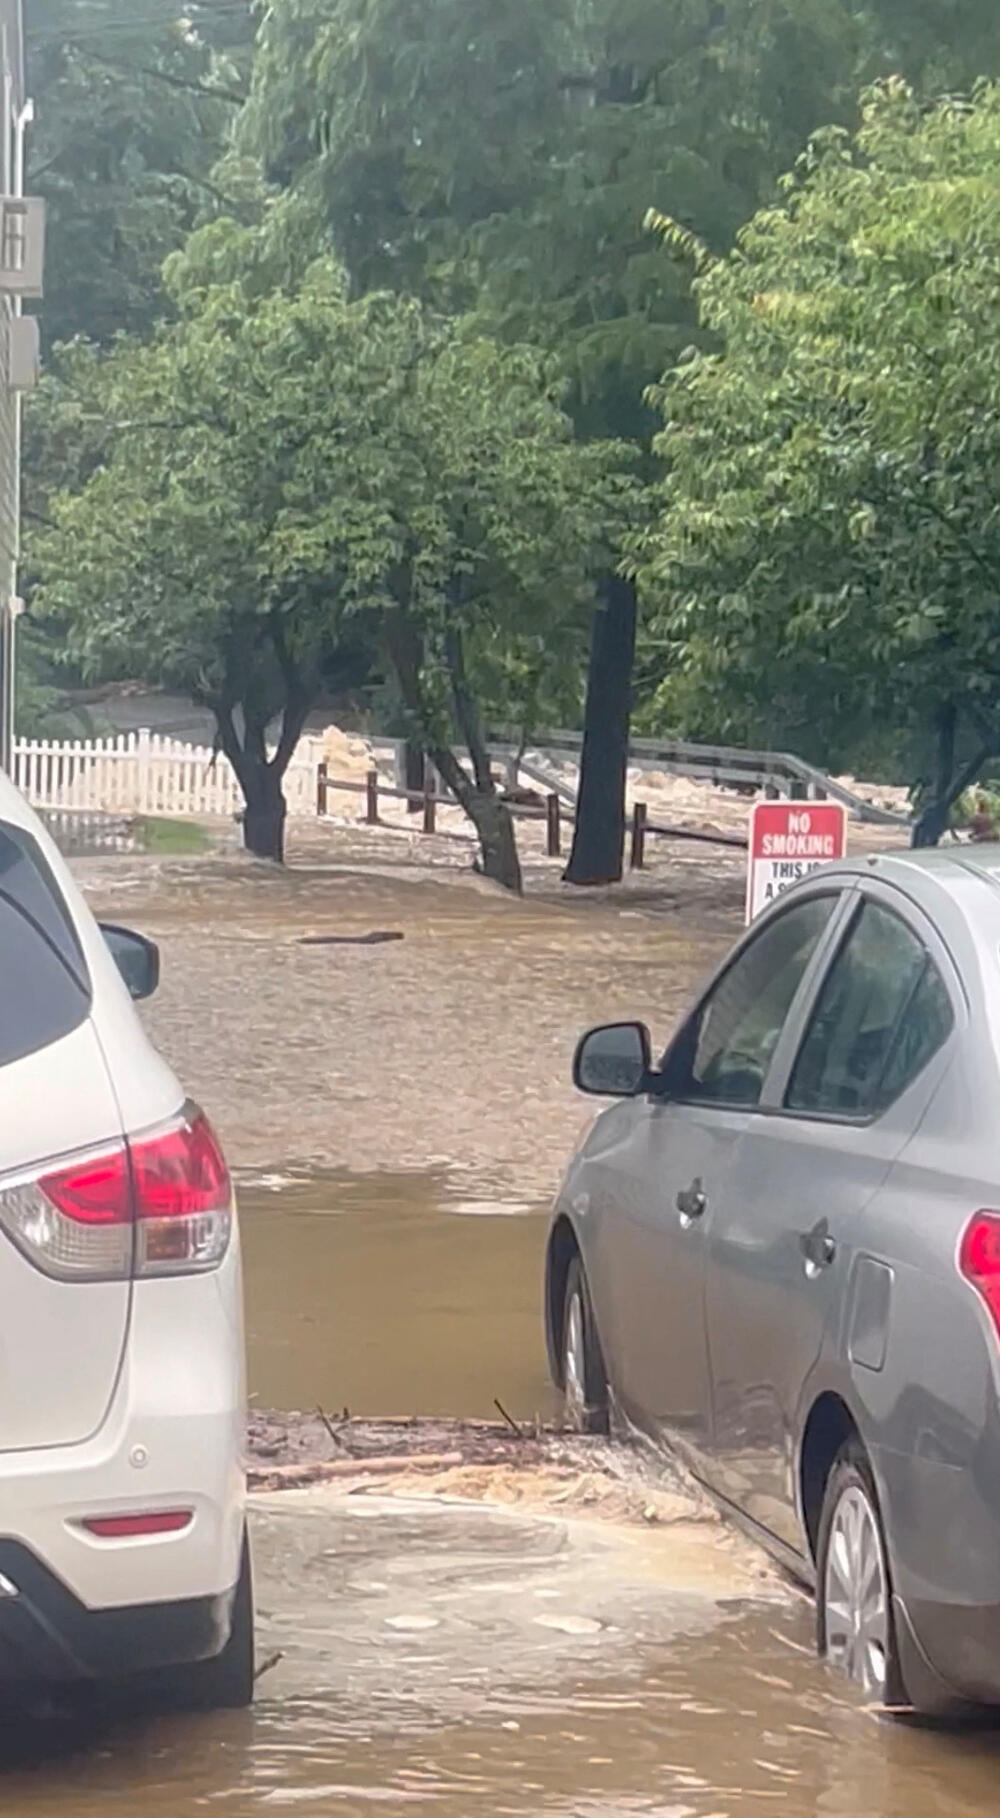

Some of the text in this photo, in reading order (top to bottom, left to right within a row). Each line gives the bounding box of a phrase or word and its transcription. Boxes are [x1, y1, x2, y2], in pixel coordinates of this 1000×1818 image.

[788, 811, 811, 833] NO
[762, 833, 834, 855] SMOKING
[772, 862, 802, 878] THIS
